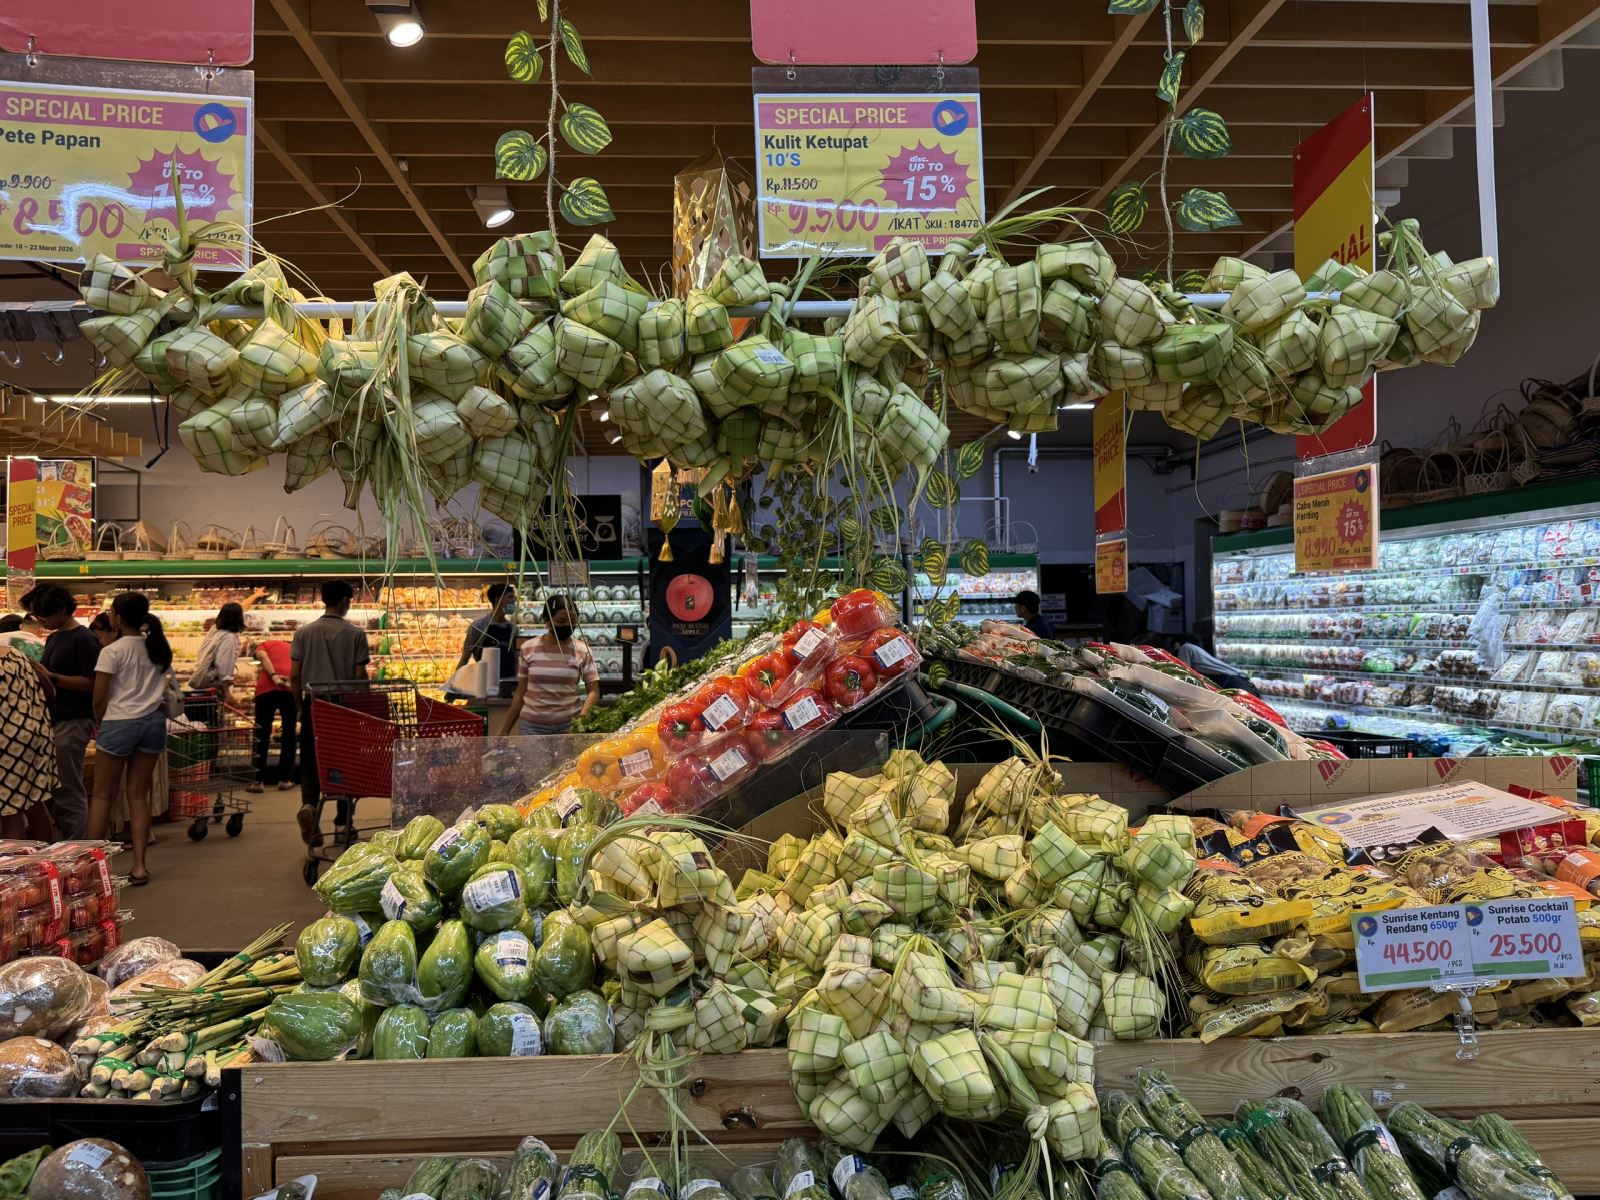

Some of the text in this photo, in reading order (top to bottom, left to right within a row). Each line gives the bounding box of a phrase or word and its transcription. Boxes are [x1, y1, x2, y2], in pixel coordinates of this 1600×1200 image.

[6, 97, 164, 125] SPECIAL PRICE
[775, 107, 907, 125] SPECIAL PRICE
[41, 129, 101, 150] Papan
[764, 135, 869, 152] Kulit Ketupat
[766, 153, 801, 167] 10'S
[909, 163, 944, 172] UP TO
[184, 169, 203, 180] TO
[0, 174, 52, 192] p.9.900
[903, 174, 956, 201] 15%
[788, 199, 880, 234] 9.500
[949, 219, 979, 229] 18478
[194, 250, 218, 260] RICE
[1094, 418, 1123, 458] SPECIAL
[1098, 439, 1120, 473] PRICE
[1300, 477, 1347, 493] SPECIAL PRICE
[9, 502, 36, 516] SPECIAL
[1296, 499, 1330, 510] Cabe Merah
[12, 514, 32, 528] PRICE
[1344, 518, 1363, 537] 15%
[1488, 902, 1569, 914] Sunrise Cocktail
[1382, 910, 1460, 924] Sunrise Kentang
[1497, 913, 1562, 924] Potato 500gr
[1386, 920, 1458, 935] Rendang 650gr
[1383, 939, 1453, 965] 44.500
[1489, 932, 1562, 957] 25.500
